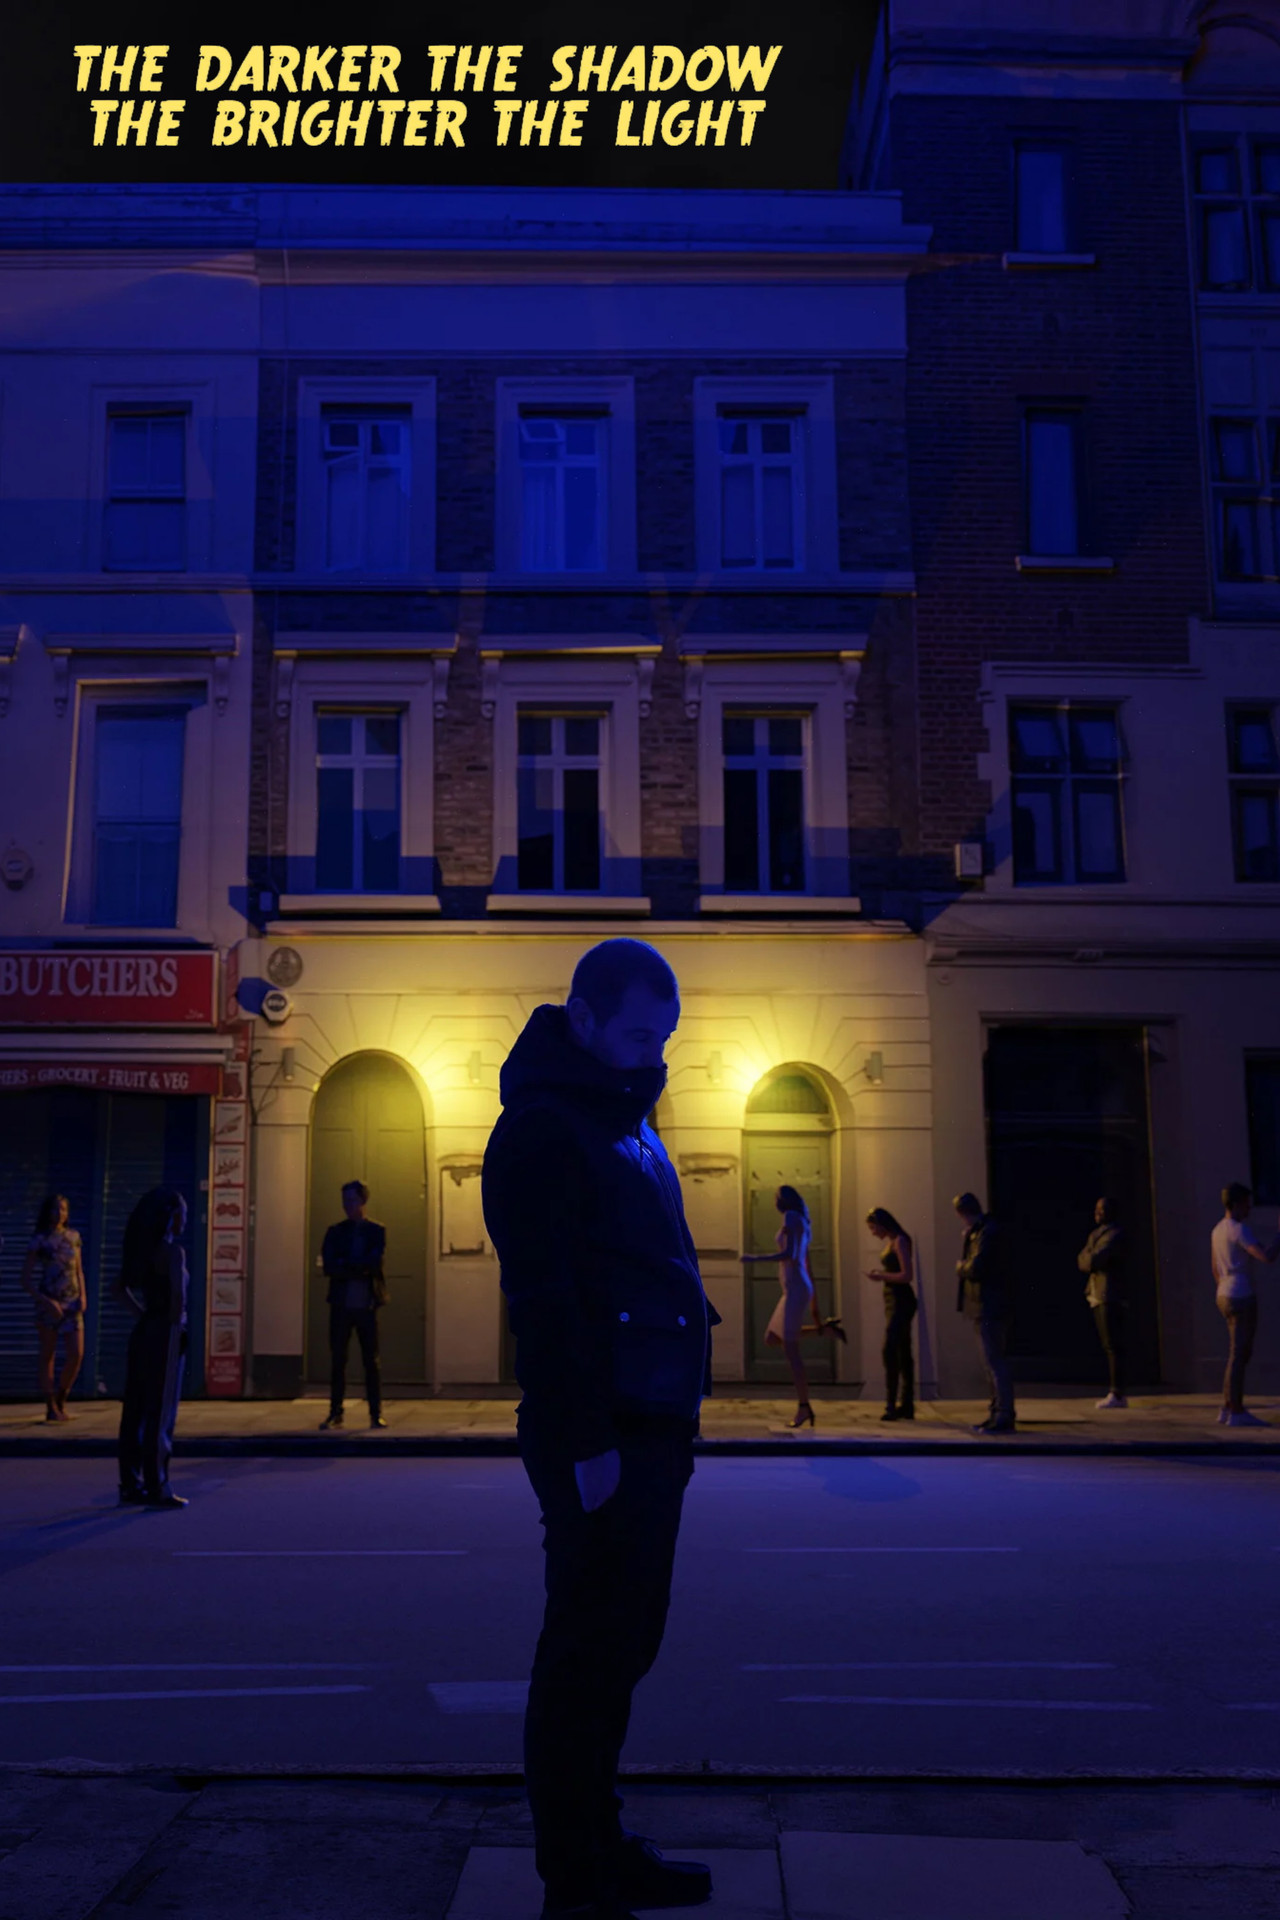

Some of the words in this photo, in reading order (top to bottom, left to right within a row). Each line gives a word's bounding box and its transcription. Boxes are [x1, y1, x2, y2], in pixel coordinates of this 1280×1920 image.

[0, 957, 179, 997] BUTCHERS
[37, 1068, 100, 1085] GROCERY
[108, 1069, 148, 1089] FRUIT
[148, 1073, 160, 1090] &
[163, 1071, 189, 1091] VEG
